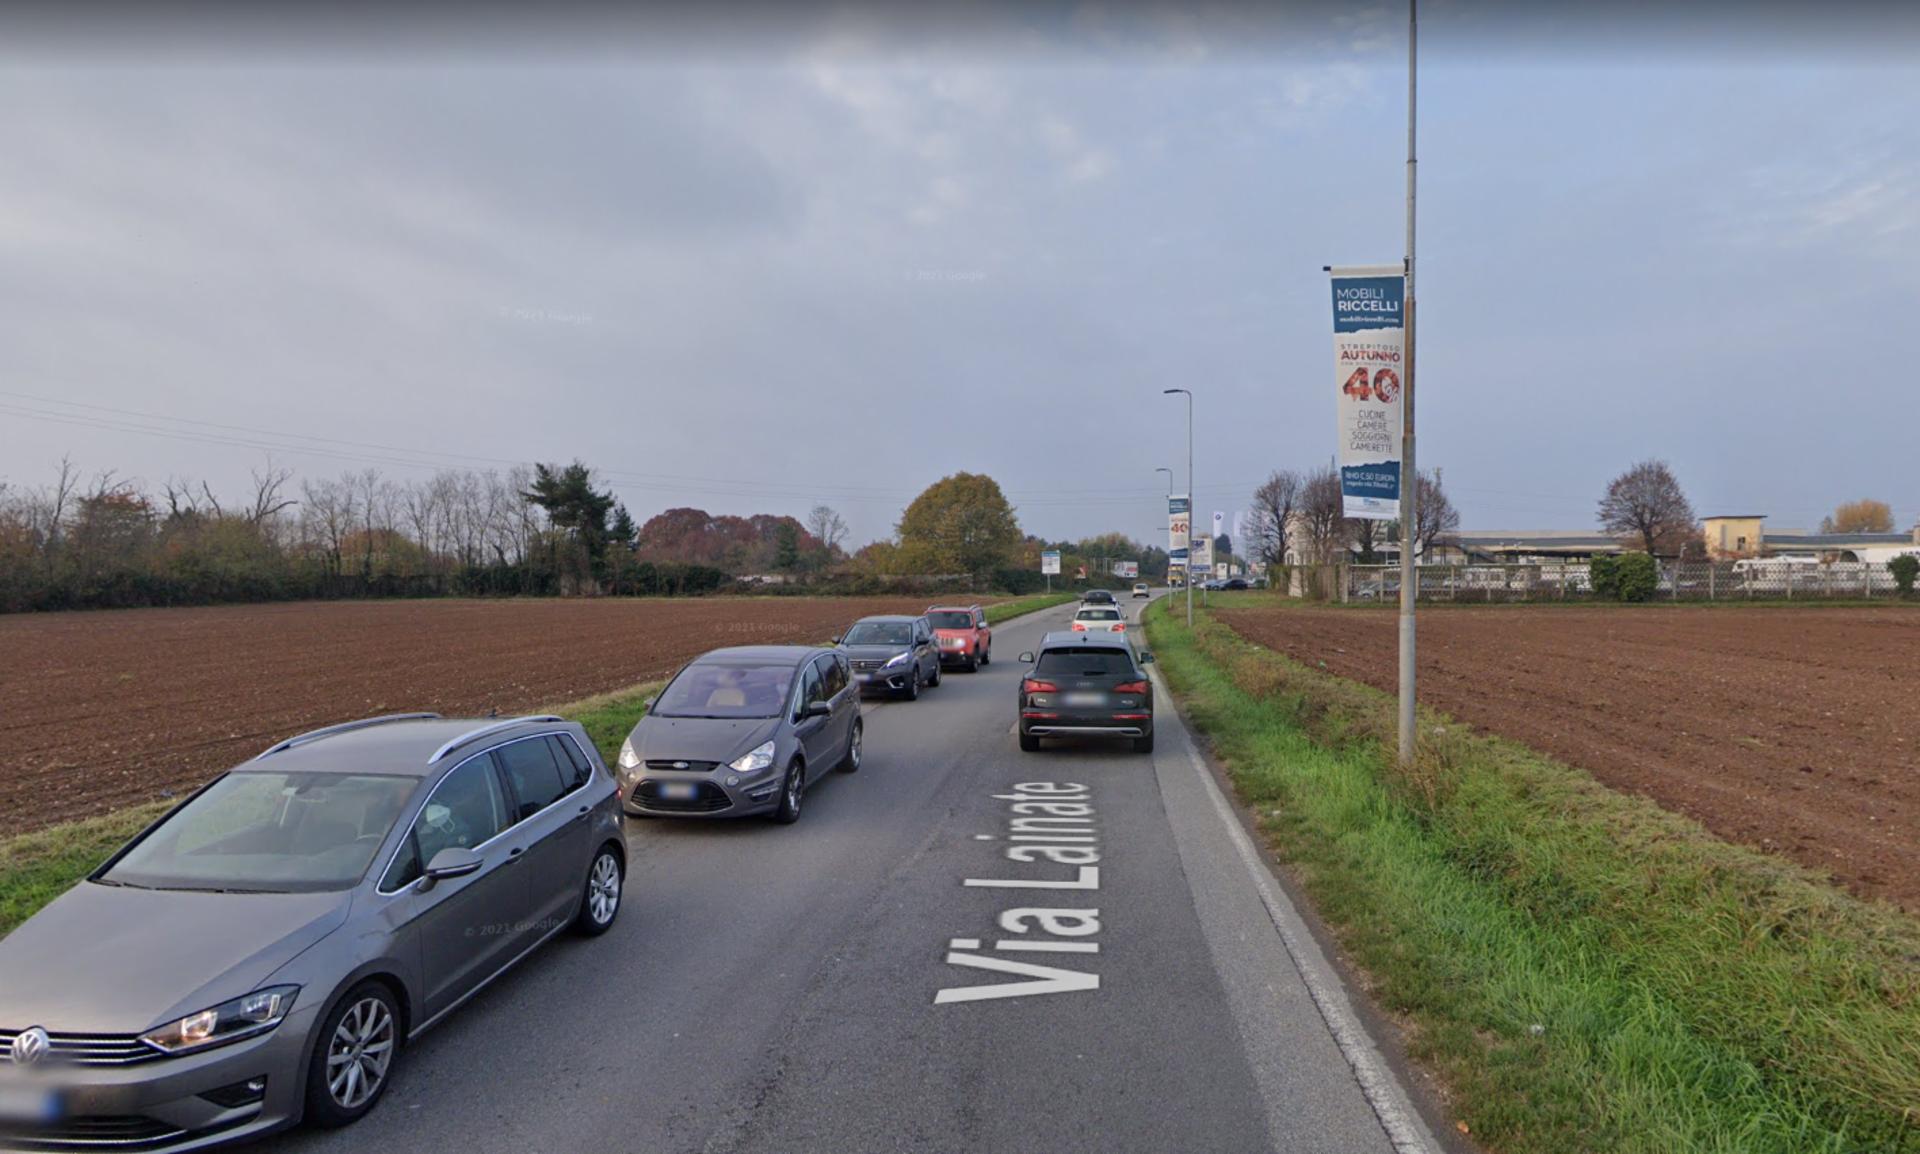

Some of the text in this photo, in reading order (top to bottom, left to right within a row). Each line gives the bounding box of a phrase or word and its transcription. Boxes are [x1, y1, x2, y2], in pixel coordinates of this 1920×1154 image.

[1336, 288, 1384, 300] MOBILI
[1338, 300, 1398, 312] RICCELLI
[1340, 343, 1400, 352] STREPITOSO
[1341, 350, 1400, 362] AUTUNNO
[1358, 409, 1386, 421] CUCINE
[1357, 420, 1388, 432] CAMERE
[1351, 430, 1392, 442] SOGGIORNI
[1350, 441, 1393, 454] CAMERETTE
